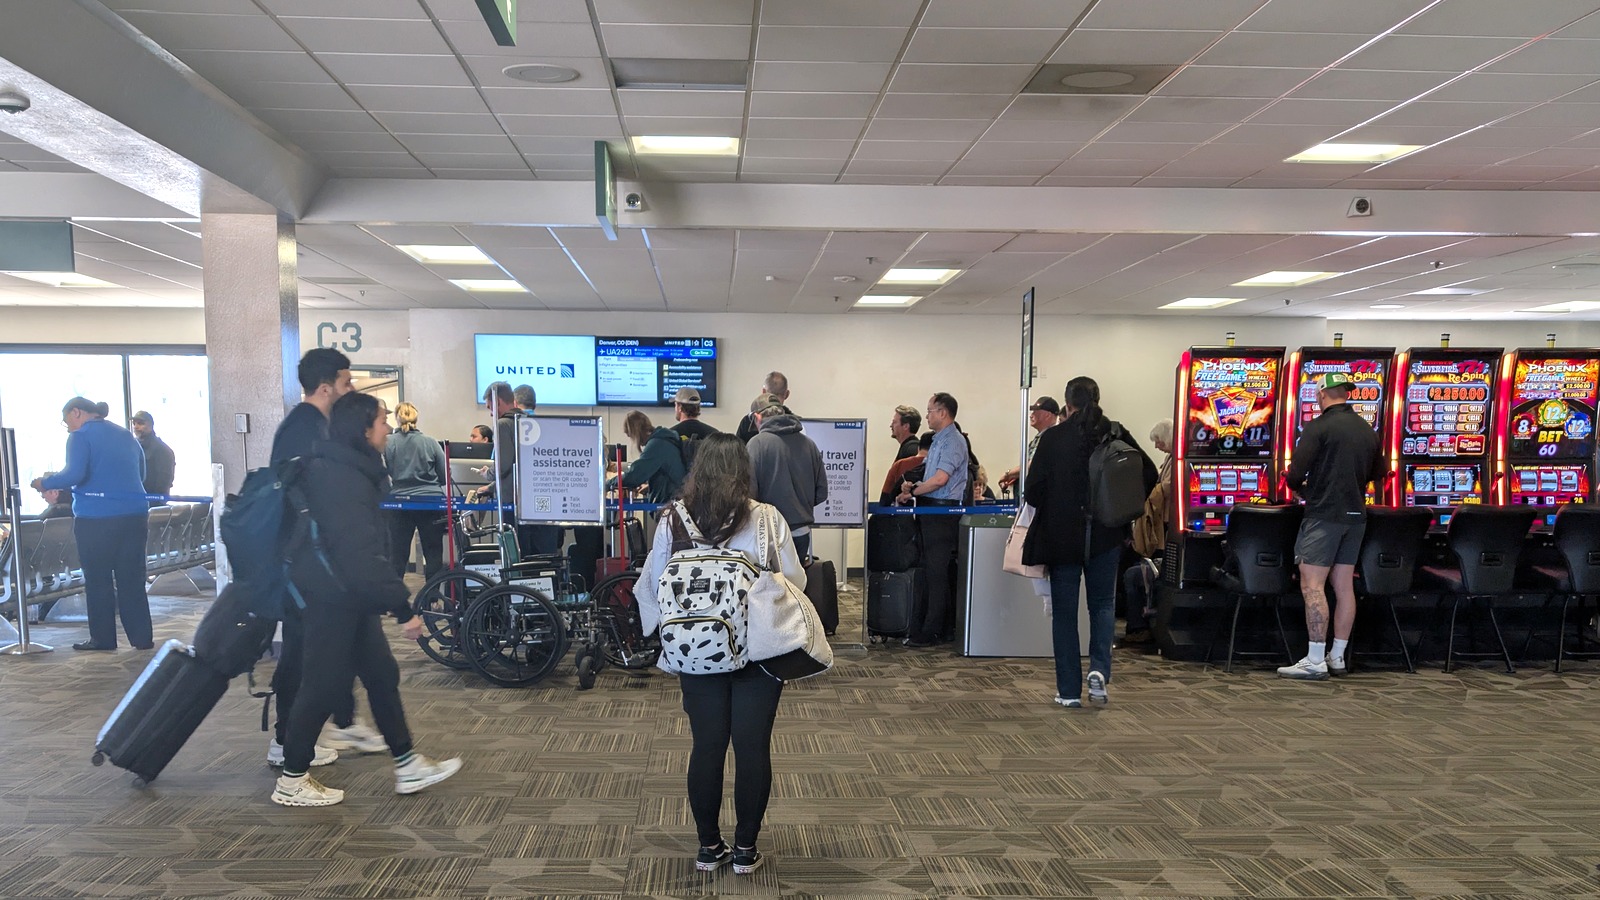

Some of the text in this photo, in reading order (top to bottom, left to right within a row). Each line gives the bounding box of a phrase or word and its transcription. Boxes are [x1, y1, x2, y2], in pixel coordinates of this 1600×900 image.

[317, 322, 362, 352] C3
[606, 348, 633, 356] UA2421
[495, 366, 557, 376] UNITED
[1200, 360, 1269, 372] PHOENIX
[1349, 359, 1377, 373] 777
[1457, 359, 1486, 373] 777
[1527, 363, 1588, 373] PHOENIX
[1195, 371, 1219, 381] FREE
[1218, 371, 1248, 382] GAMES
[1525, 374, 1542, 382] FREE
[1542, 374, 1565, 382] GAMES
[1218, 405, 1247, 417] JACKPOT
[1546, 406, 1560, 420] 12
[1518, 419, 1529, 433] 8
[1570, 419, 1585, 433] 12
[1196, 427, 1206, 440] 6
[1249, 427, 1262, 440] 11
[1538, 430, 1564, 443] BET
[1223, 435, 1234, 448] 8
[533, 447, 593, 457] Need travel
[827, 450, 857, 460] travel
[1539, 443, 1557, 456] 60
[533, 458, 591, 468] assistance?
[1365, 497, 1374, 505] 24
